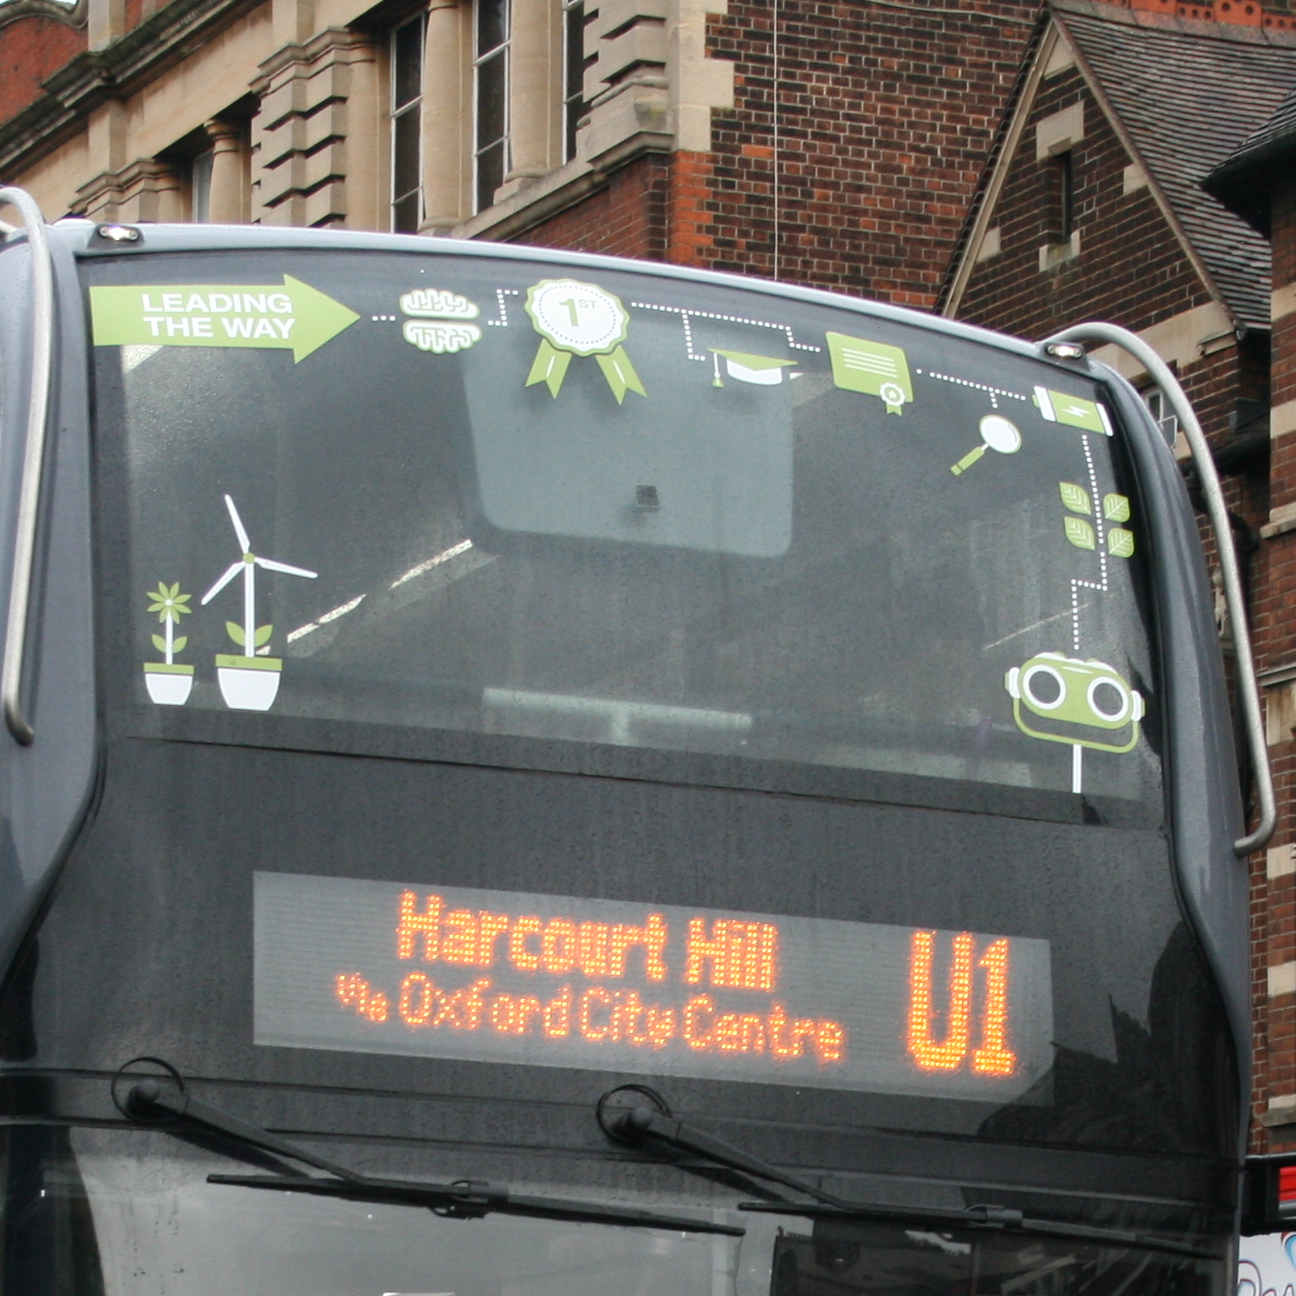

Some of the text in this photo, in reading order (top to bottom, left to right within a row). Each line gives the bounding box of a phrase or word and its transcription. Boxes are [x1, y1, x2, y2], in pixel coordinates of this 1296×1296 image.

[141, 293, 293, 314] LEADING
[142, 316, 296, 339] THE WAY
[558, 298, 597, 327] 1ST
[396, 888, 779, 993] Harcourt Hill
[399, 971, 571, 1038] Oxford
[580, 987, 675, 1049] City
[682, 992, 846, 1060] Centre
[908, 930, 1016, 1077] U1
